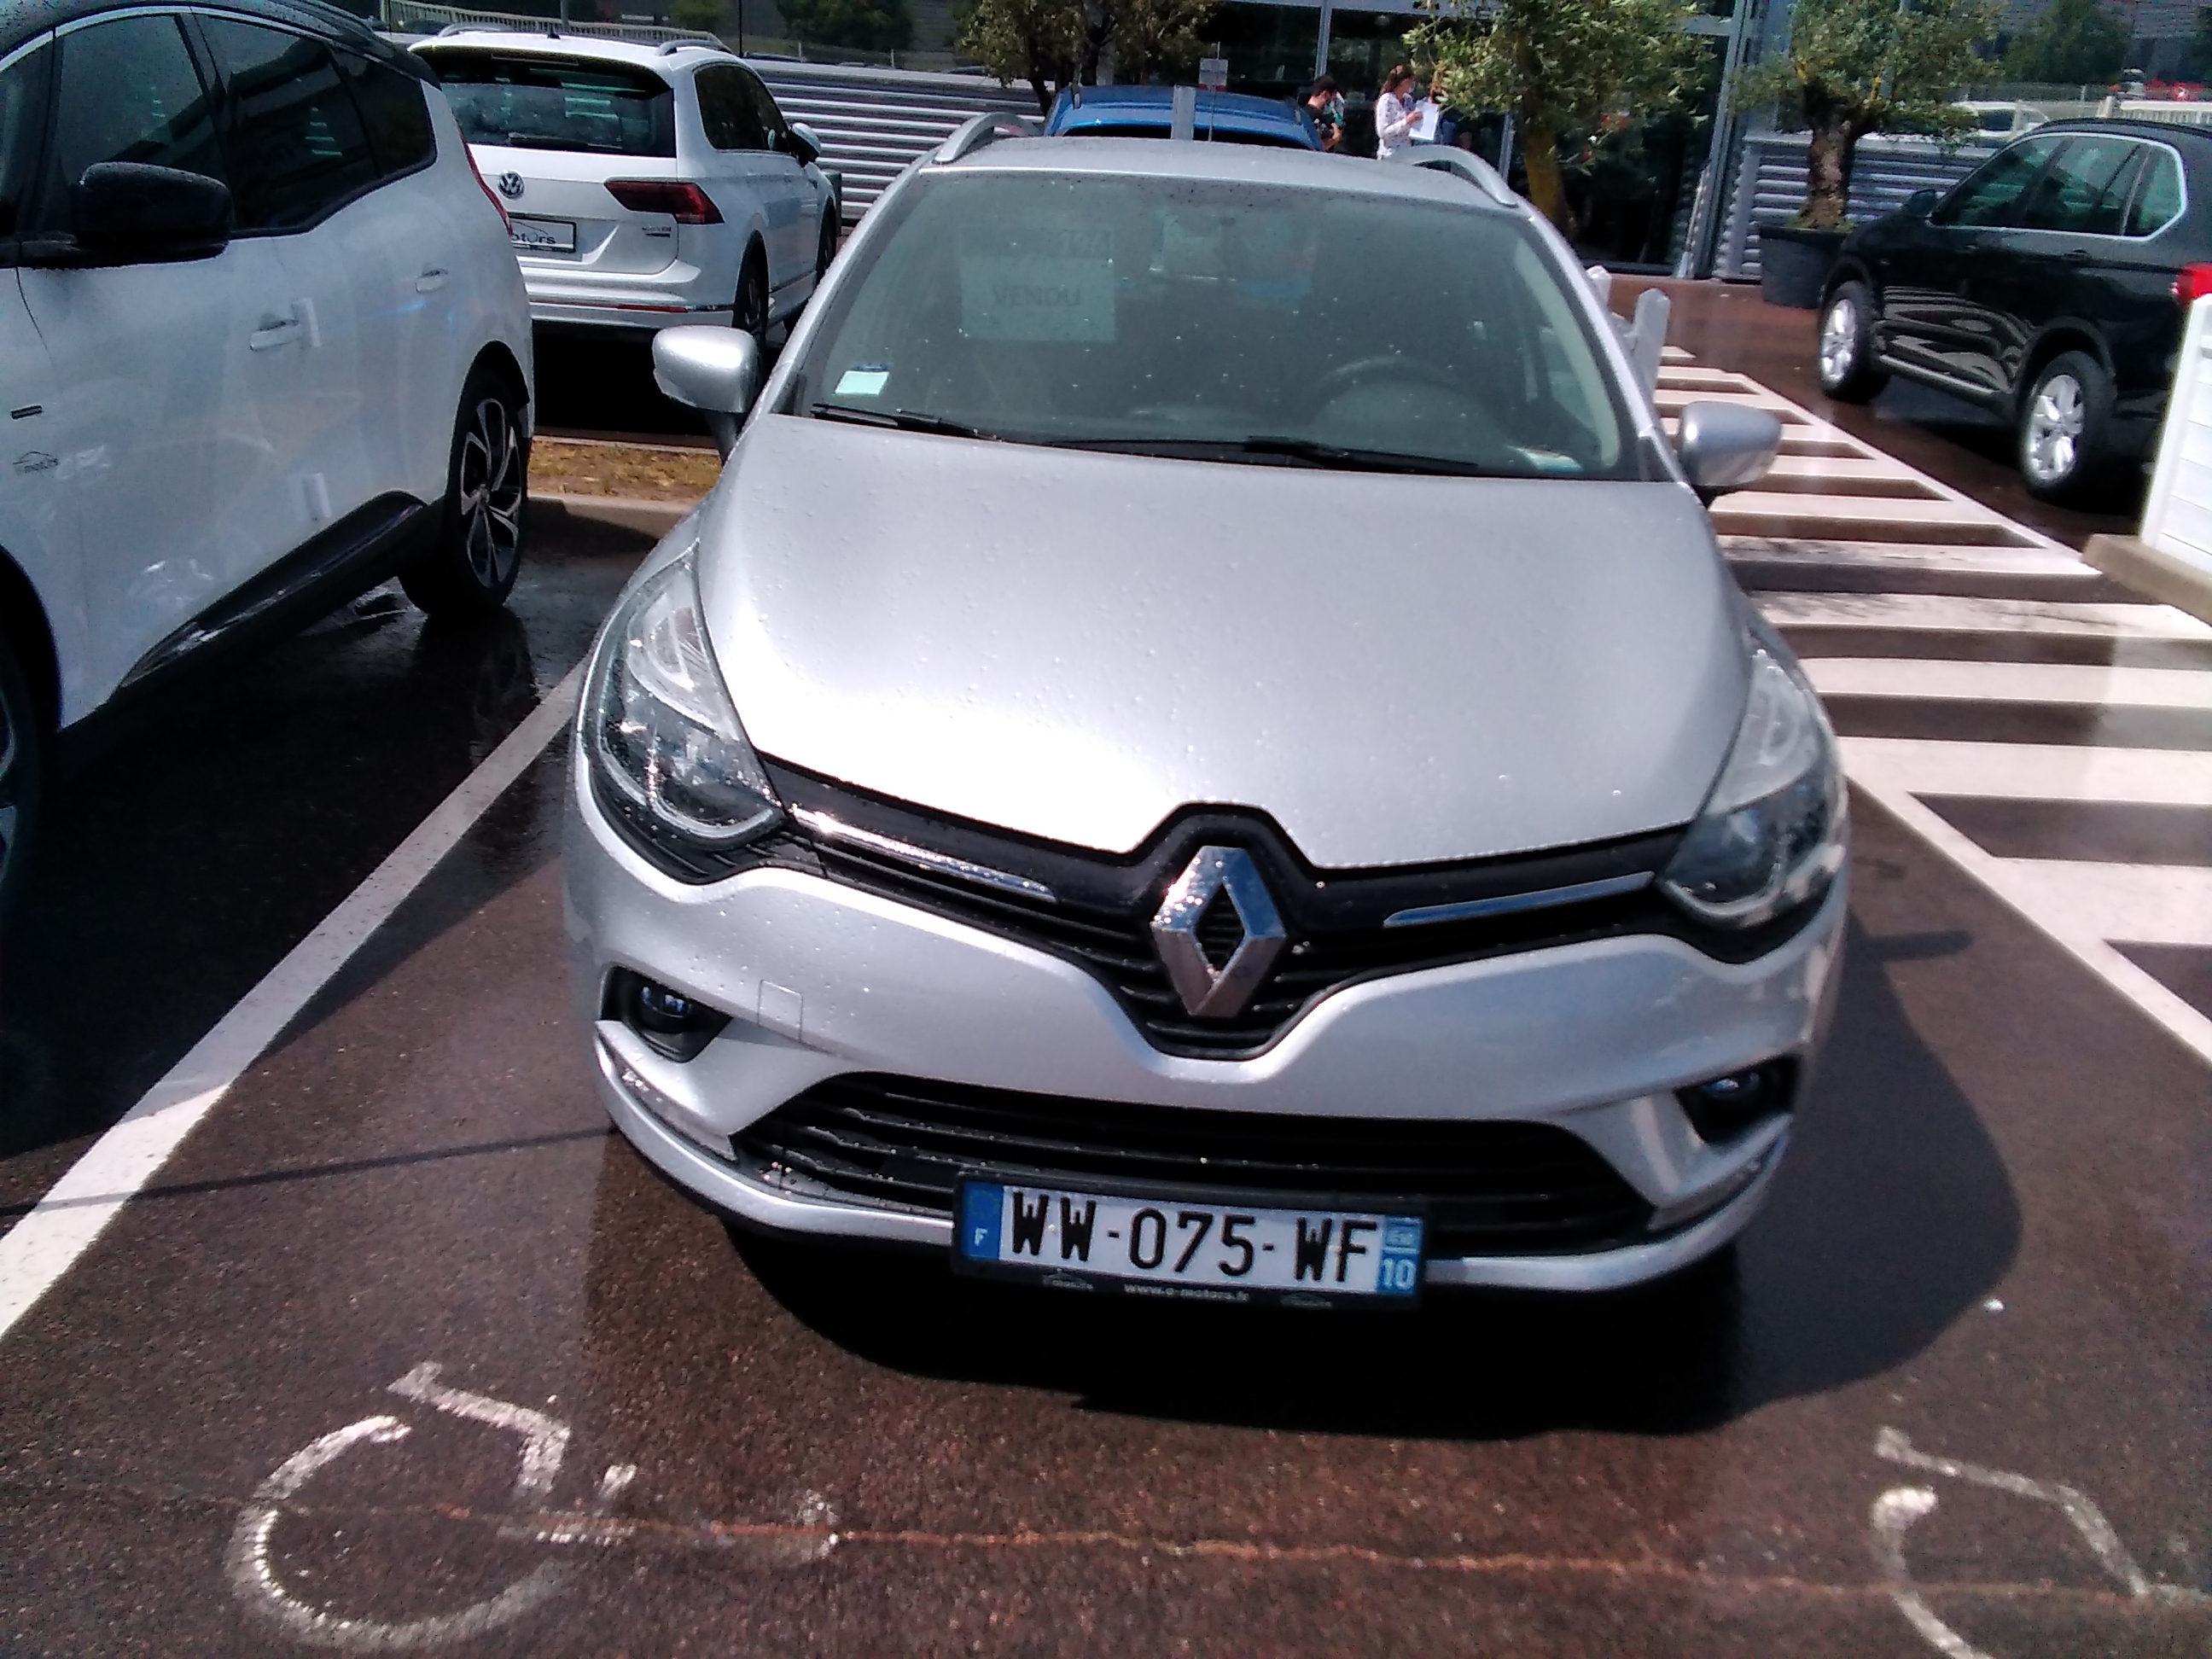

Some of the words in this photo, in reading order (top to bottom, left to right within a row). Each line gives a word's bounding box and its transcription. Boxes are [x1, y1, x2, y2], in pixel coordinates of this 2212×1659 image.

[992, 284, 1080, 307] VENDU
[974, 1227, 988, 1247] F
[1013, 1191, 1377, 1281] WW-075-WF
[1382, 1258, 1417, 1290] 10
